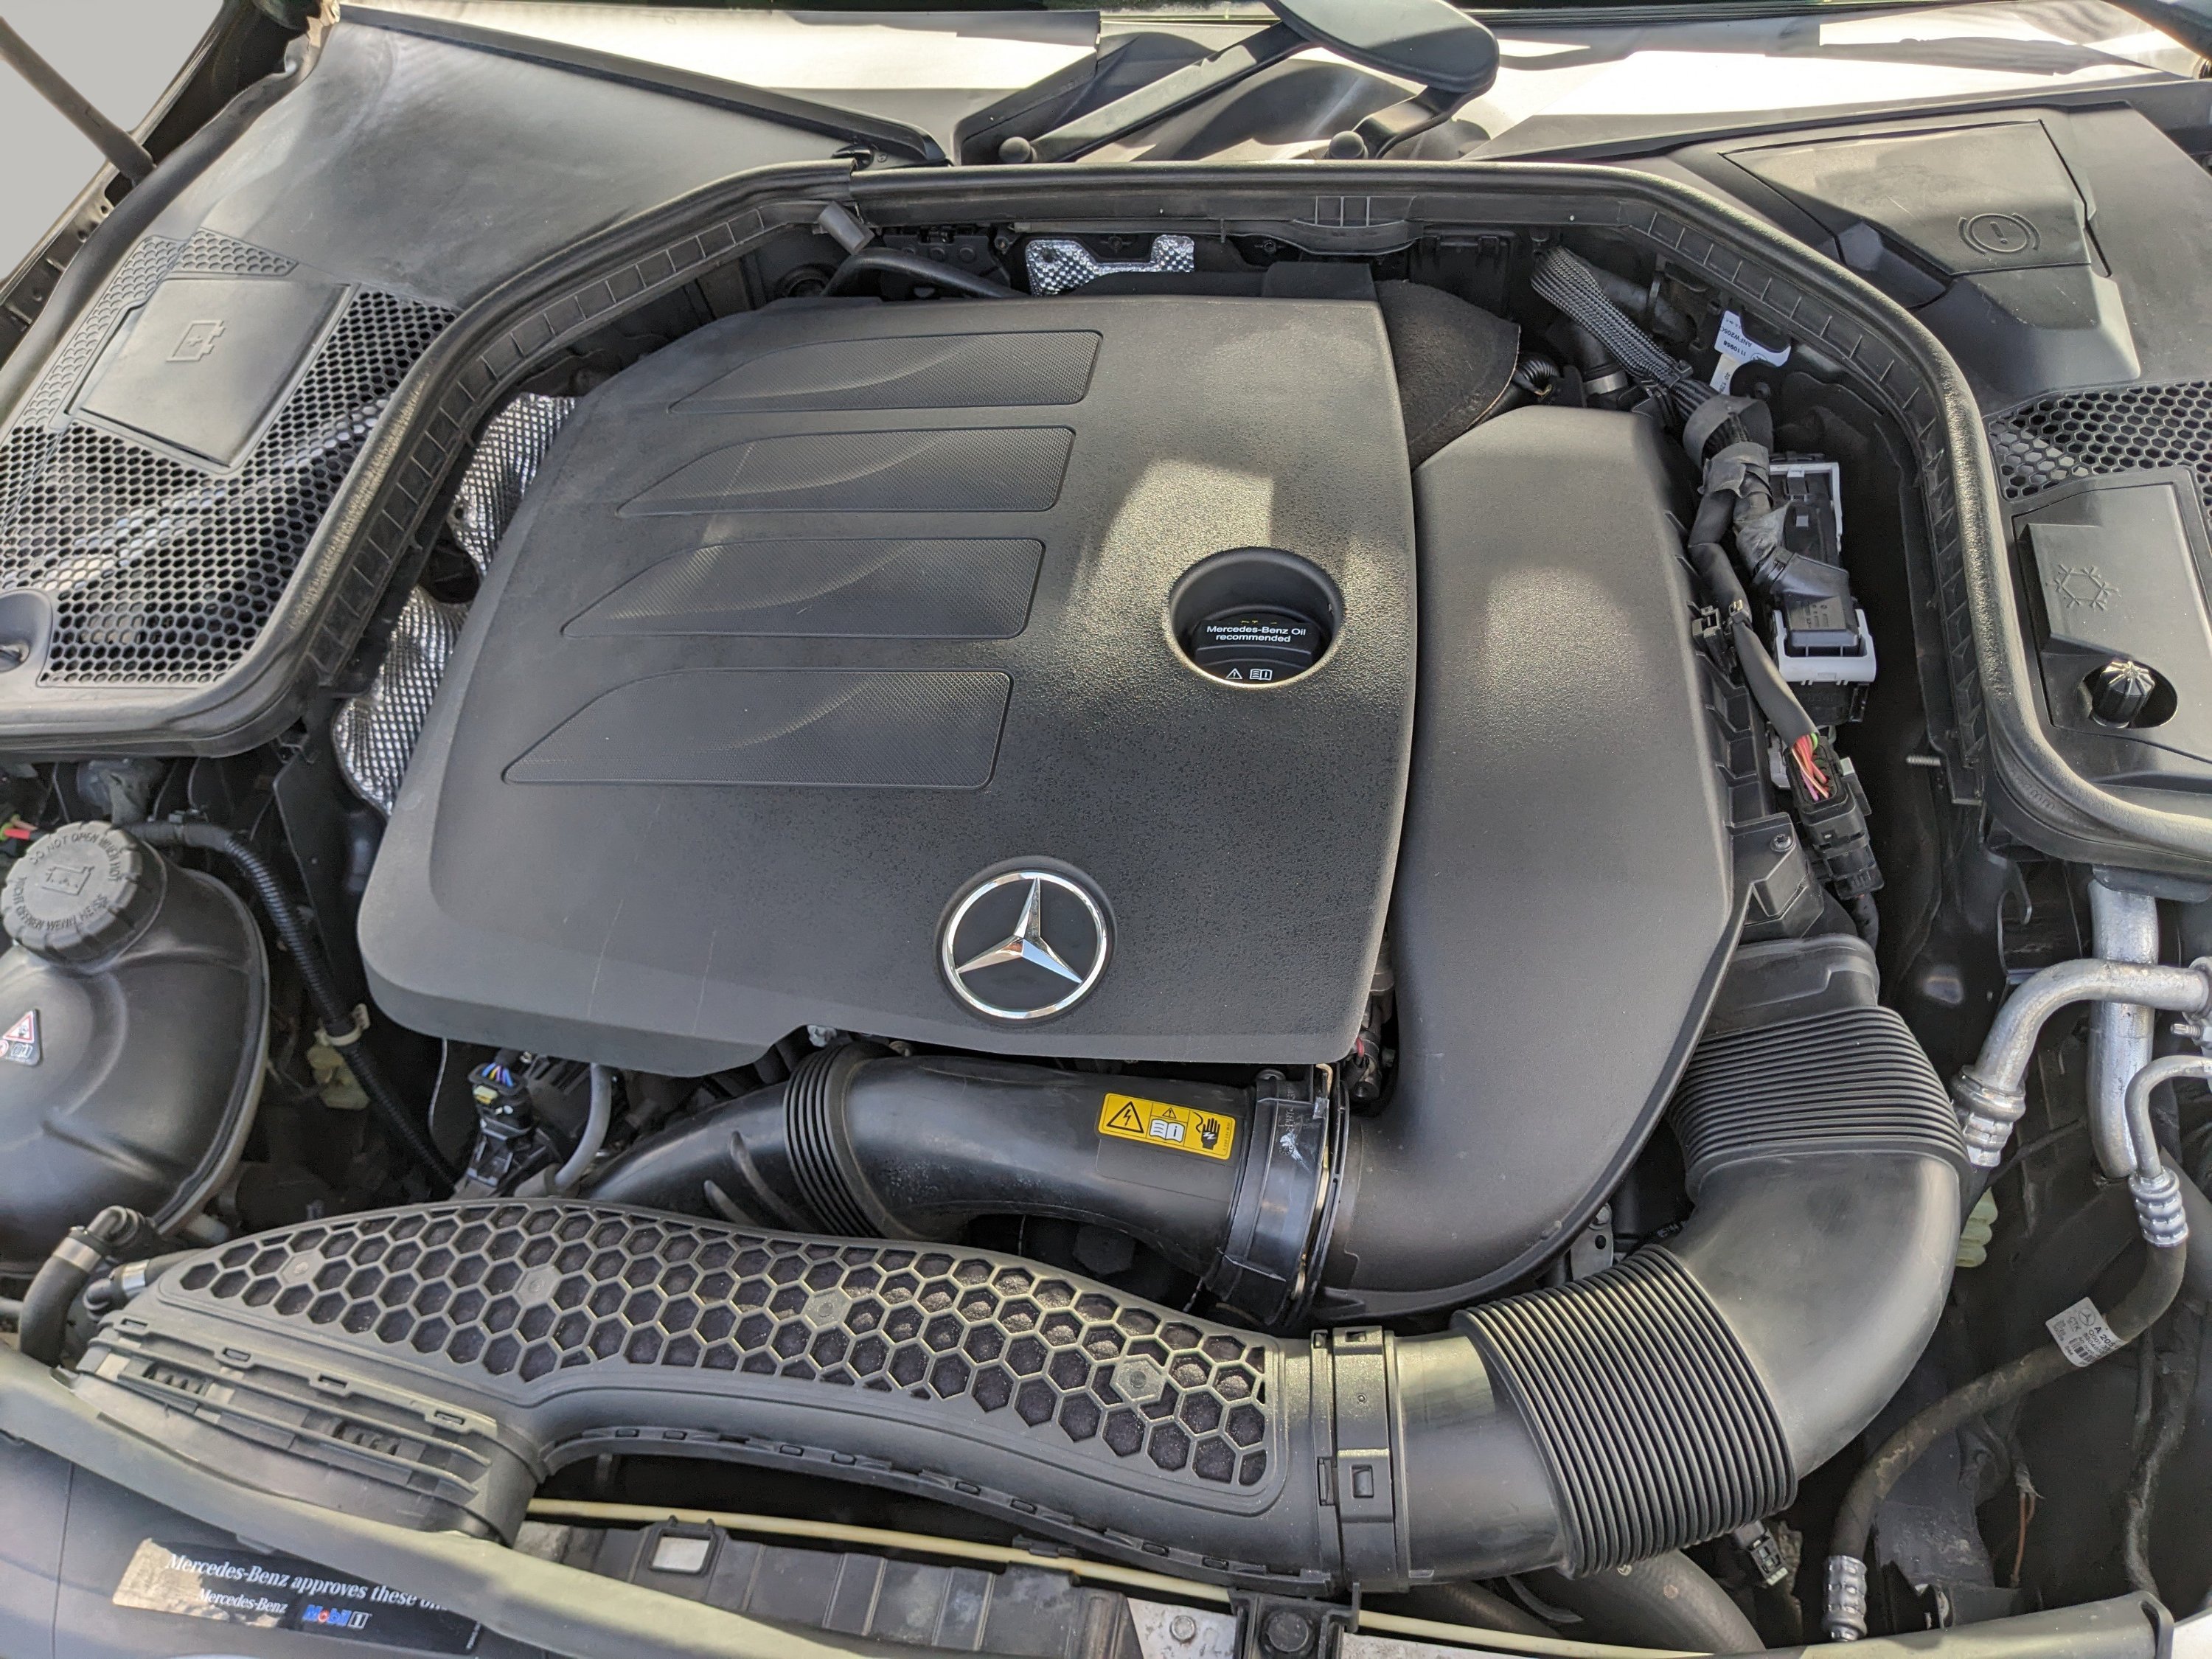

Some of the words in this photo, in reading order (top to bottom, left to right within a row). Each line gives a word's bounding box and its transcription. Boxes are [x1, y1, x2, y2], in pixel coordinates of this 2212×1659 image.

[1206, 625, 1288, 635] Mercedes-Benz
[1291, 627, 1307, 636] Oil
[1216, 634, 1291, 643] recommended
[46, 835, 68, 852] NOT
[71, 831, 99, 844] OPEN
[166, 1553, 290, 1587] Mercedes-Benz
[291, 1576, 369, 1597] approves
[370, 1585, 417, 1606] these
[197, 1587, 289, 1614] Mercedes-Benz
[302, 1604, 352, 1627] Mobil
